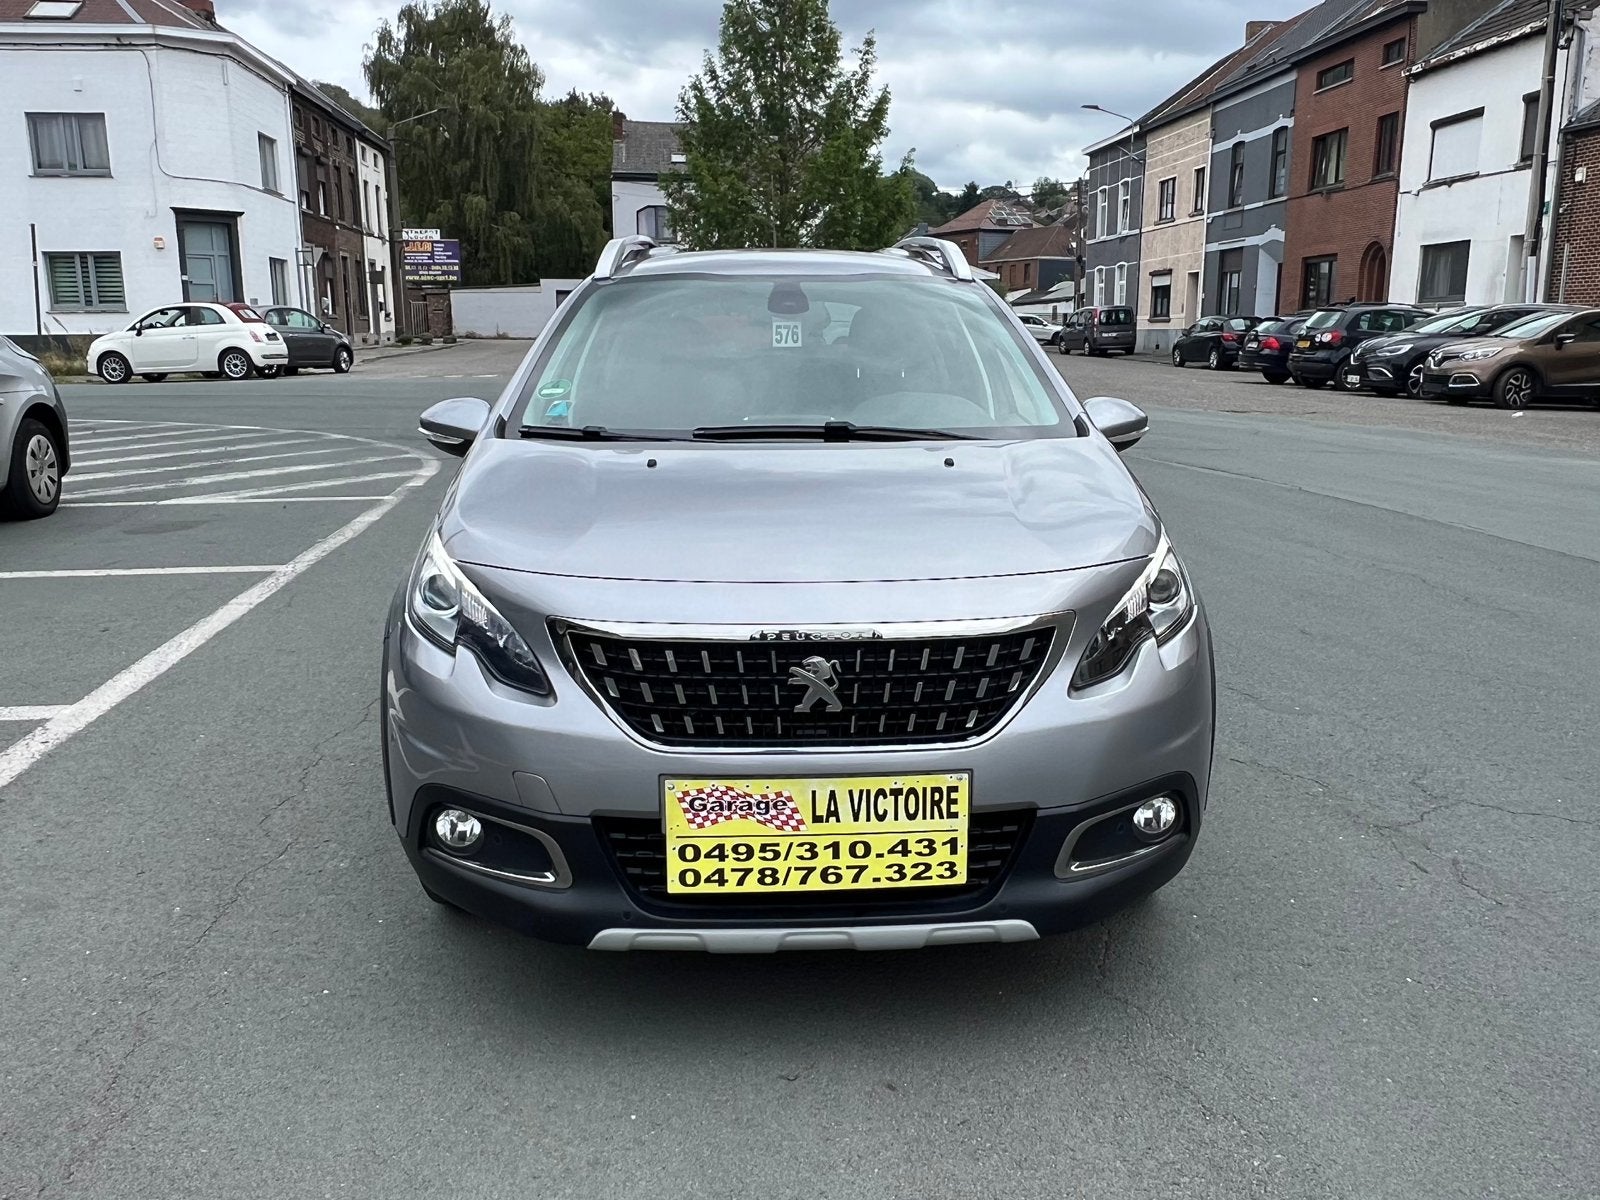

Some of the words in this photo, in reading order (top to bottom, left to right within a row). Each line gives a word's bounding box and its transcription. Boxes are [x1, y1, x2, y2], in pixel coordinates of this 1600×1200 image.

[775, 325, 799, 344] 576
[767, 631, 865, 640] PEUGEOT
[688, 796, 788, 816] Garage
[811, 789, 841, 823] LA
[848, 786, 959, 822] VICTOIRE
[677, 837, 959, 863] 0495/310.431
[678, 861, 958, 888] 0478/767.323
